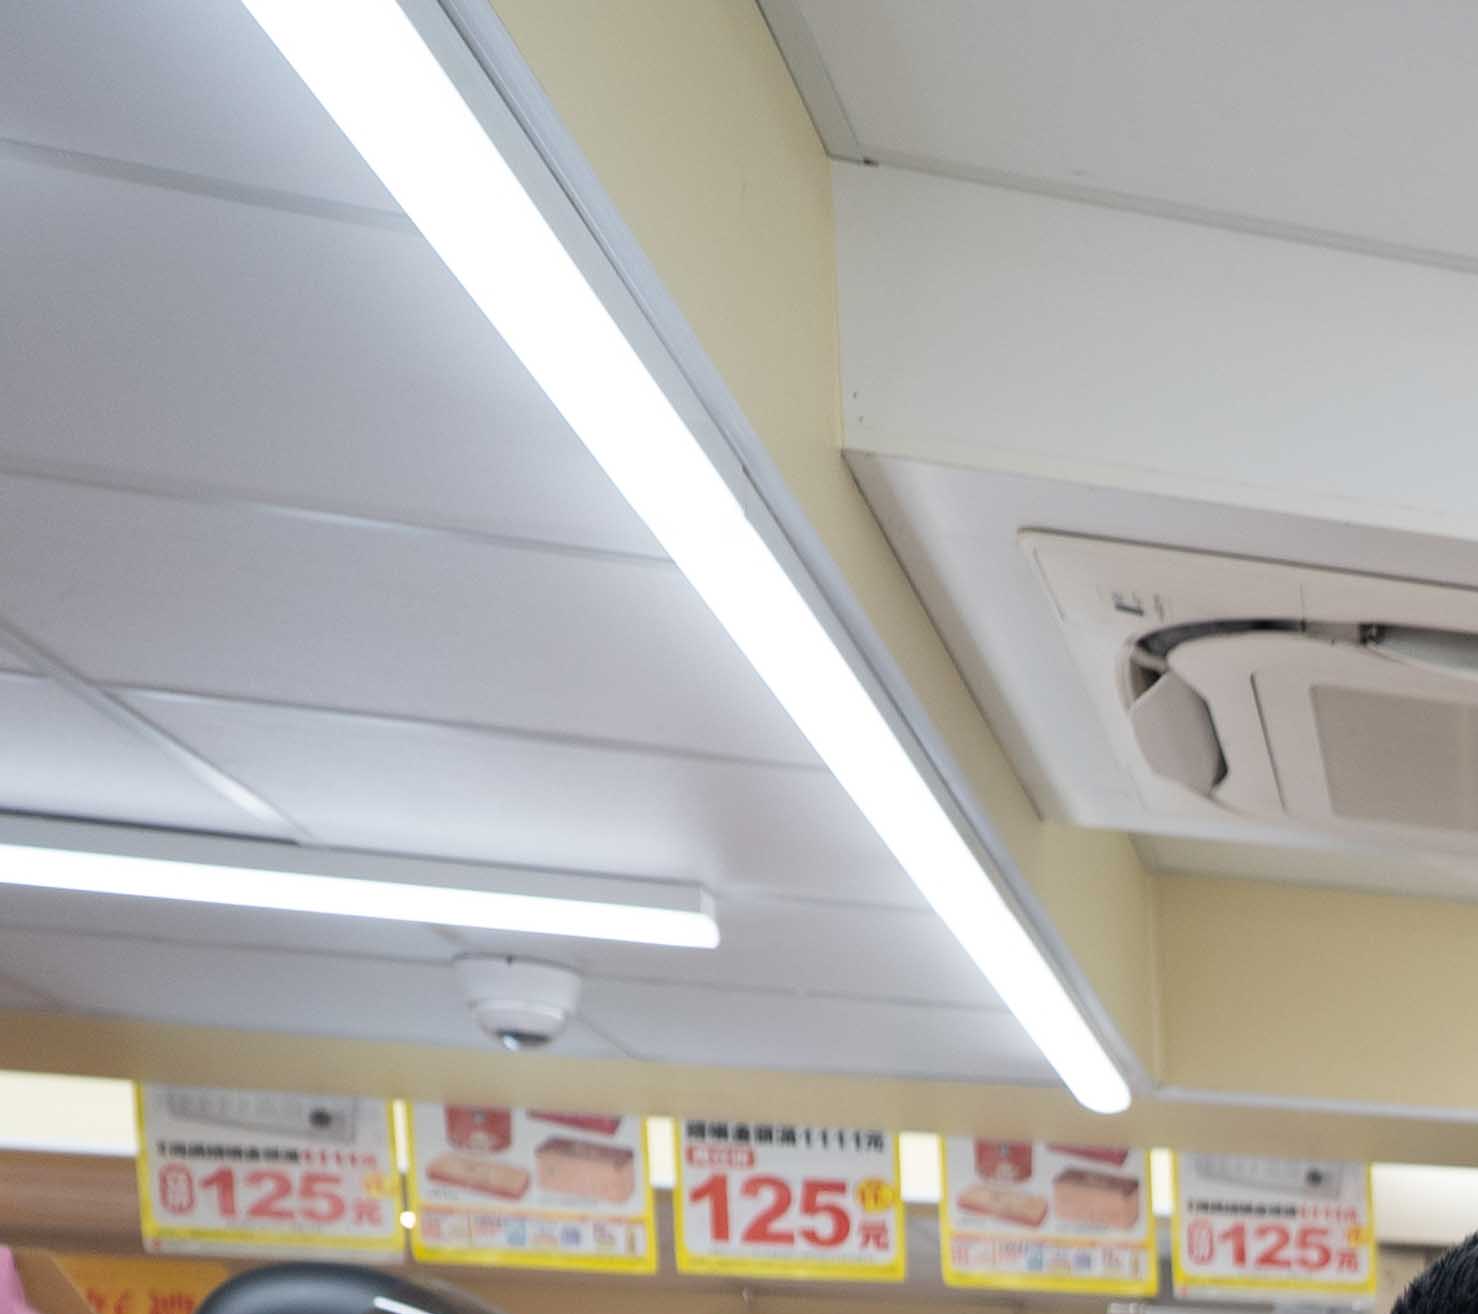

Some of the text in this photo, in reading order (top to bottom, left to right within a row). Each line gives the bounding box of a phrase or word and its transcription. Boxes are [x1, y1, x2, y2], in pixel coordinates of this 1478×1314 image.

[202, 1167, 345, 1222] 125
[689, 1174, 850, 1246] 125
[1219, 1223, 1330, 1270] 125
